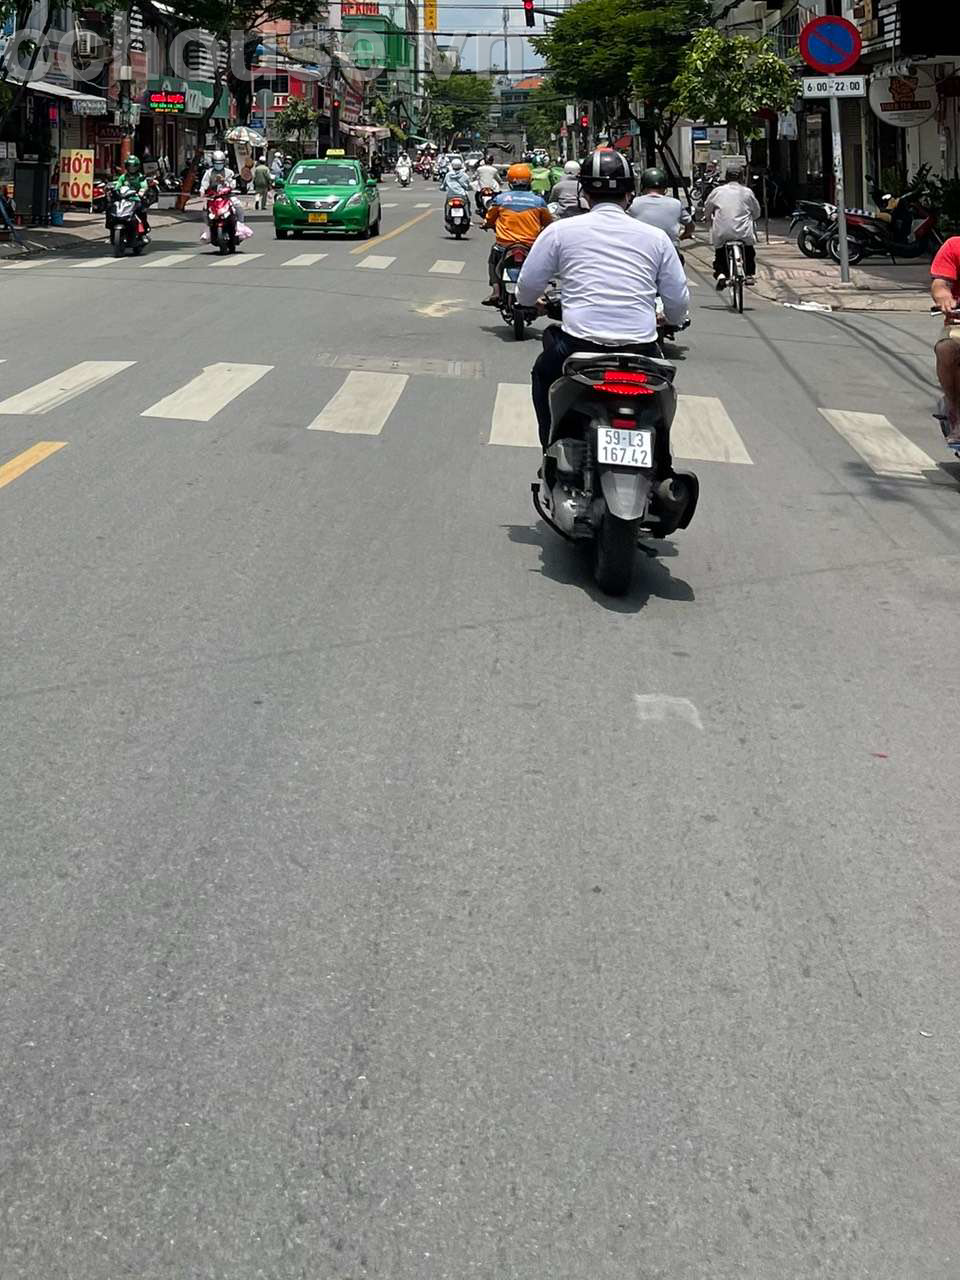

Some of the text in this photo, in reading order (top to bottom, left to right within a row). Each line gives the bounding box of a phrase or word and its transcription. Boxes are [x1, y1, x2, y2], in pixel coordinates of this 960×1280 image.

[62, 152, 93, 173] HỚT
[61, 178, 92, 198] TÓC
[605, 430, 644, 448] 59-L3
[603, 446, 648, 465] 167.42
